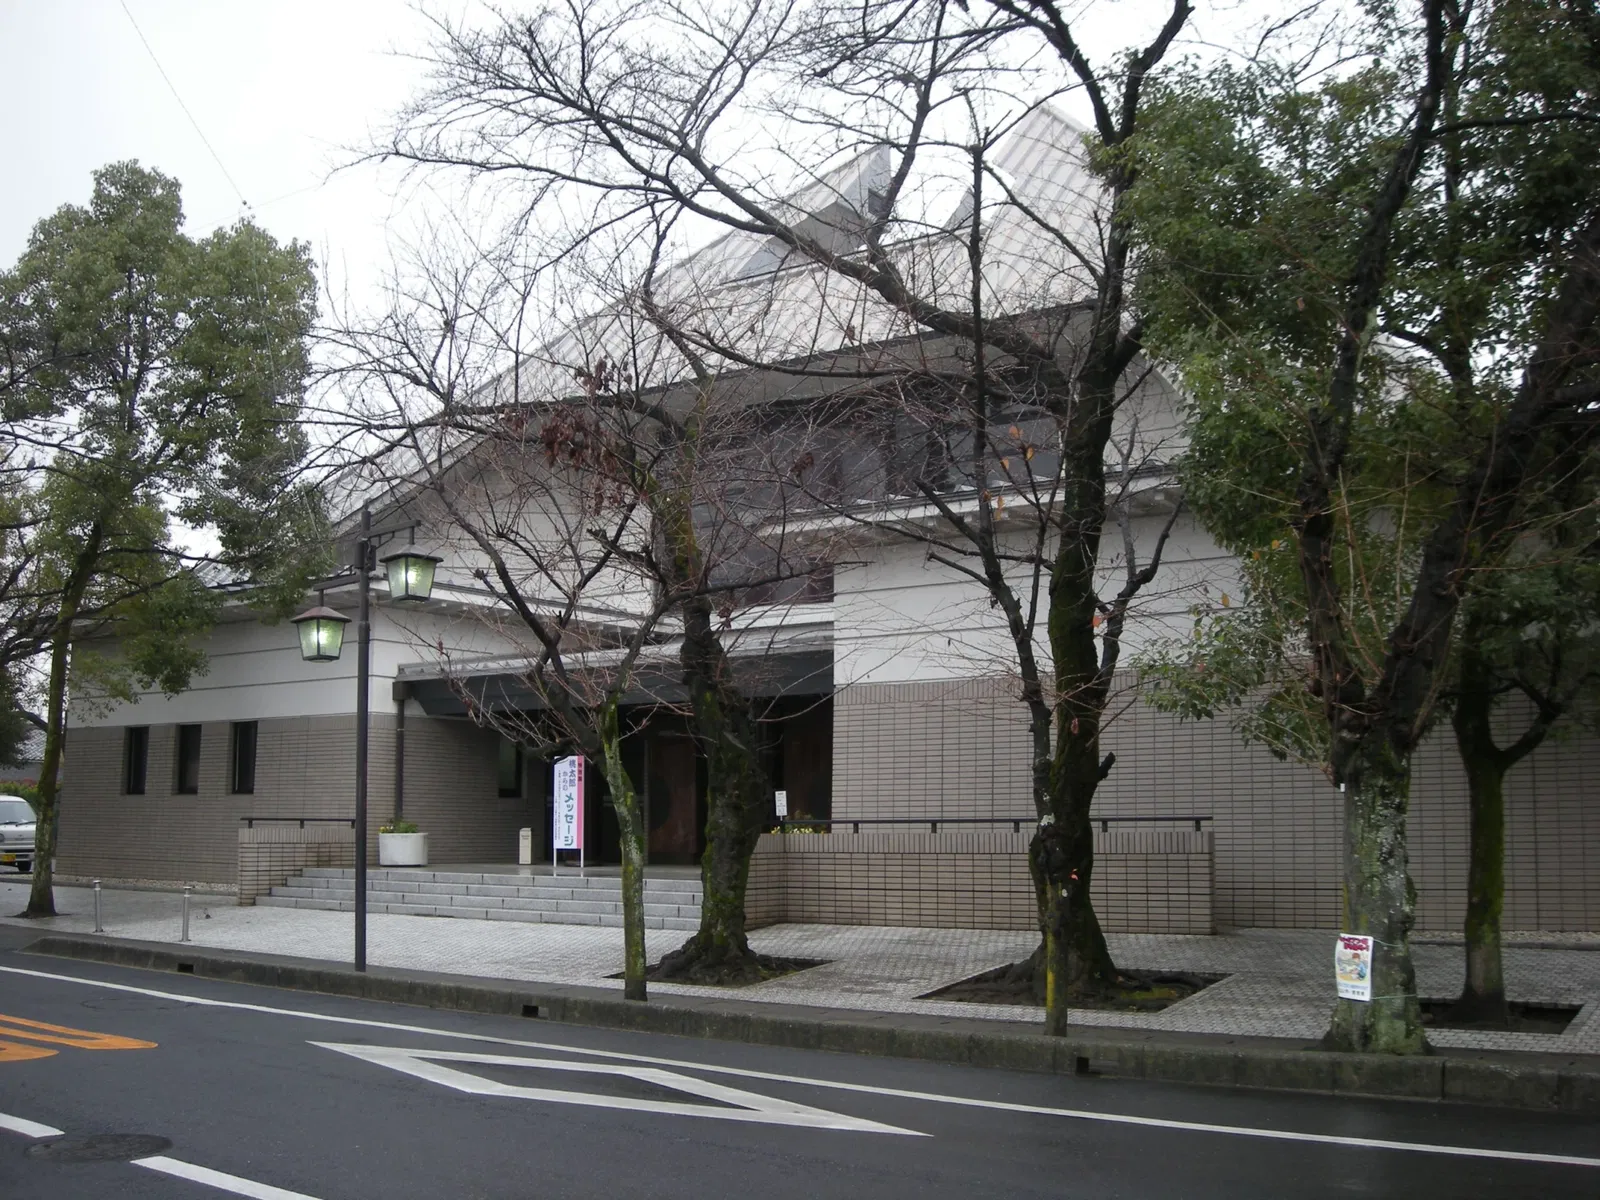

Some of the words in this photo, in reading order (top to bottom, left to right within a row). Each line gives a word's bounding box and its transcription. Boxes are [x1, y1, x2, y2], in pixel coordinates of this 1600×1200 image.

[564, 792, 574, 847] メッセージ
